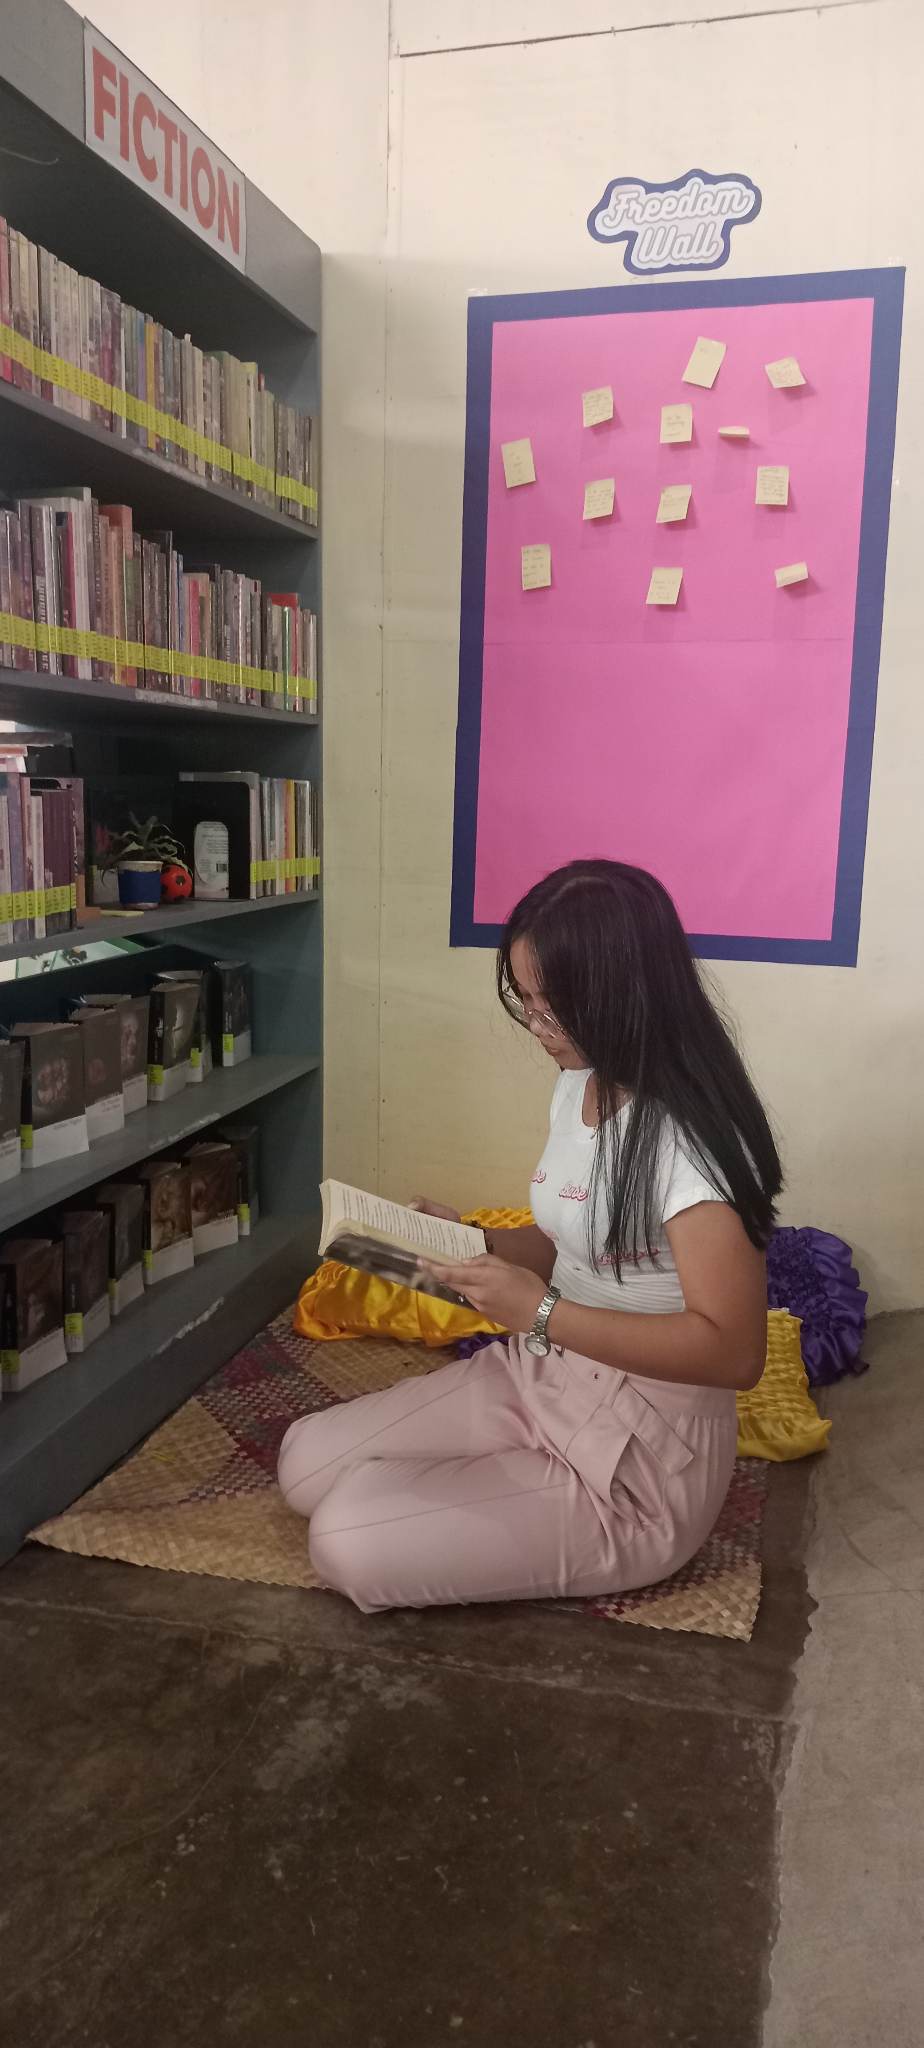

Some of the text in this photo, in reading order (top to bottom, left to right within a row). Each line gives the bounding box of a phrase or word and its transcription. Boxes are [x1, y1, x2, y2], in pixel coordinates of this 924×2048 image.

[91, 47, 241, 256] FICTION
[601, 181, 751, 229] Freedom
[637, 221, 720, 264] Wall
